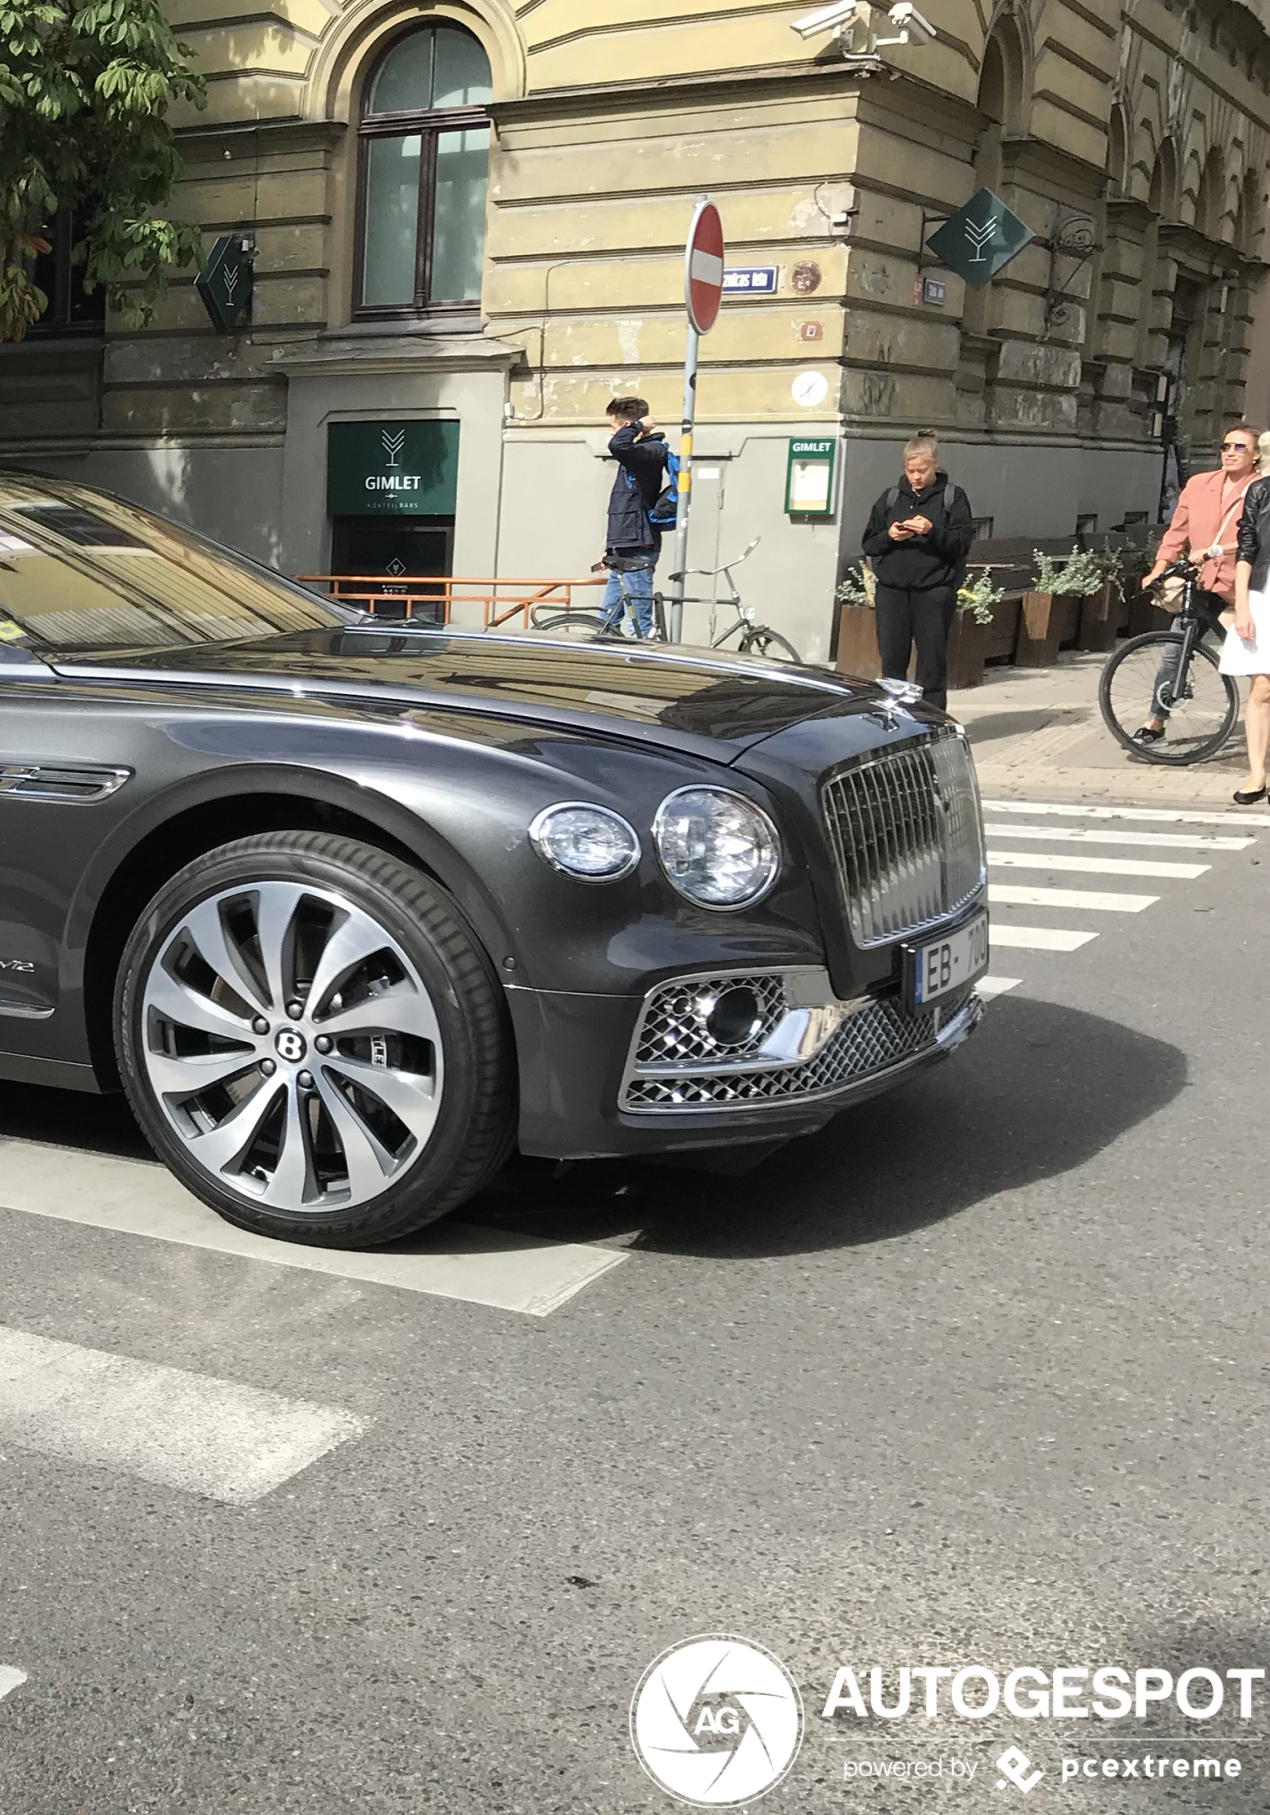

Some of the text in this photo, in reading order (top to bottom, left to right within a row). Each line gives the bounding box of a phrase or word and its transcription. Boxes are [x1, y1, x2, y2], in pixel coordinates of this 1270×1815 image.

[792, 442, 832, 452] GIMLET
[365, 476, 422, 490] GIMLET
[278, 1032, 302, 1060] B
